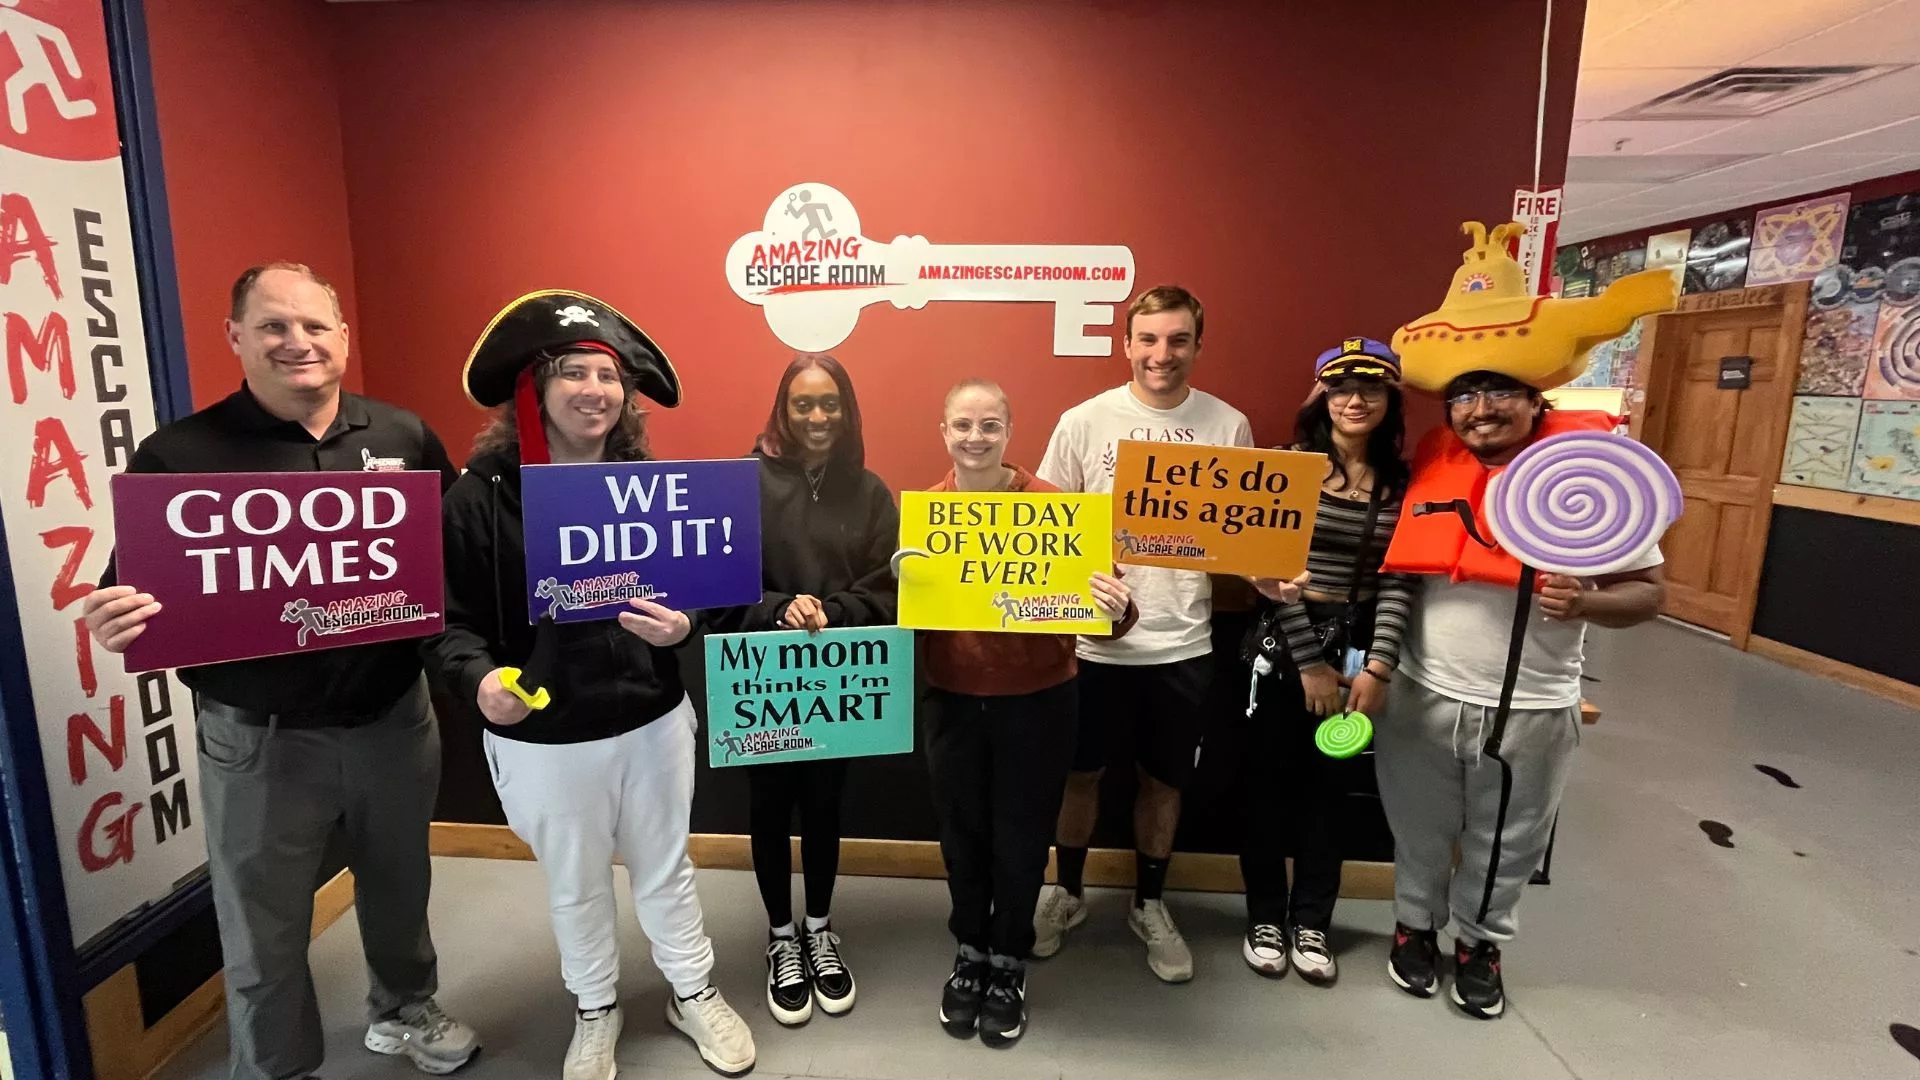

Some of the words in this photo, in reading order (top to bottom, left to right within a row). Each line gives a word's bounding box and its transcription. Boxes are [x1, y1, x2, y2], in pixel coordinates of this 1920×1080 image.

[1516, 197, 1557, 216] FIRE
[750, 236, 863, 271] AMAZING
[745, 264, 821, 286] ESCAPE
[828, 264, 886, 286] ROOM
[917, 265, 1127, 281] AMAZINGESCAPEROOM.COM
[1129, 427, 1195, 443] CLASS
[1144, 455, 1229, 490] Let's
[1239, 460, 1289, 494] do
[604, 473, 689, 514] WE
[166, 486, 407, 538] GOOD
[928, 501, 1003, 526] BEST
[1012, 502, 1081, 527] DAY
[1124, 487, 1188, 520] this
[1198, 498, 1302, 535] again
[0, 192, 144, 873] AMAZING
[73, 207, 136, 474] ESCA
[136, 669, 192, 845] OOM
[559, 522, 658, 566] DID
[671, 516, 733, 558] IT!
[926, 530, 968, 555] OF
[979, 532, 1083, 557] WORK
[1136, 542, 1174, 555] ESCAPE
[1176, 546, 1206, 558] ROOM
[1140, 534, 1195, 545] AMAZING
[185, 537, 399, 595] TIMES
[960, 560, 1052, 586] EVER!
[569, 590, 617, 604] ESCAPE
[619, 584, 654, 599] ROOM
[573, 571, 640, 594] AMAZING
[326, 590, 408, 615] AMAZING
[1022, 593, 1081, 606] AMAZING
[323, 608, 379, 629] ESCAPE
[383, 604, 423, 622] ROOM
[1018, 606, 1059, 618] ESCAPE
[1062, 607, 1094, 619] ROOM
[720, 637, 768, 681] My
[778, 639, 889, 670] mom
[731, 676, 828, 696] thinks
[840, 673, 889, 689] I'm
[735, 692, 891, 729] SMART
[741, 739, 781, 752] ESCAPE
[783, 738, 813, 749] ROOM
[743, 725, 800, 744] AMAZING
